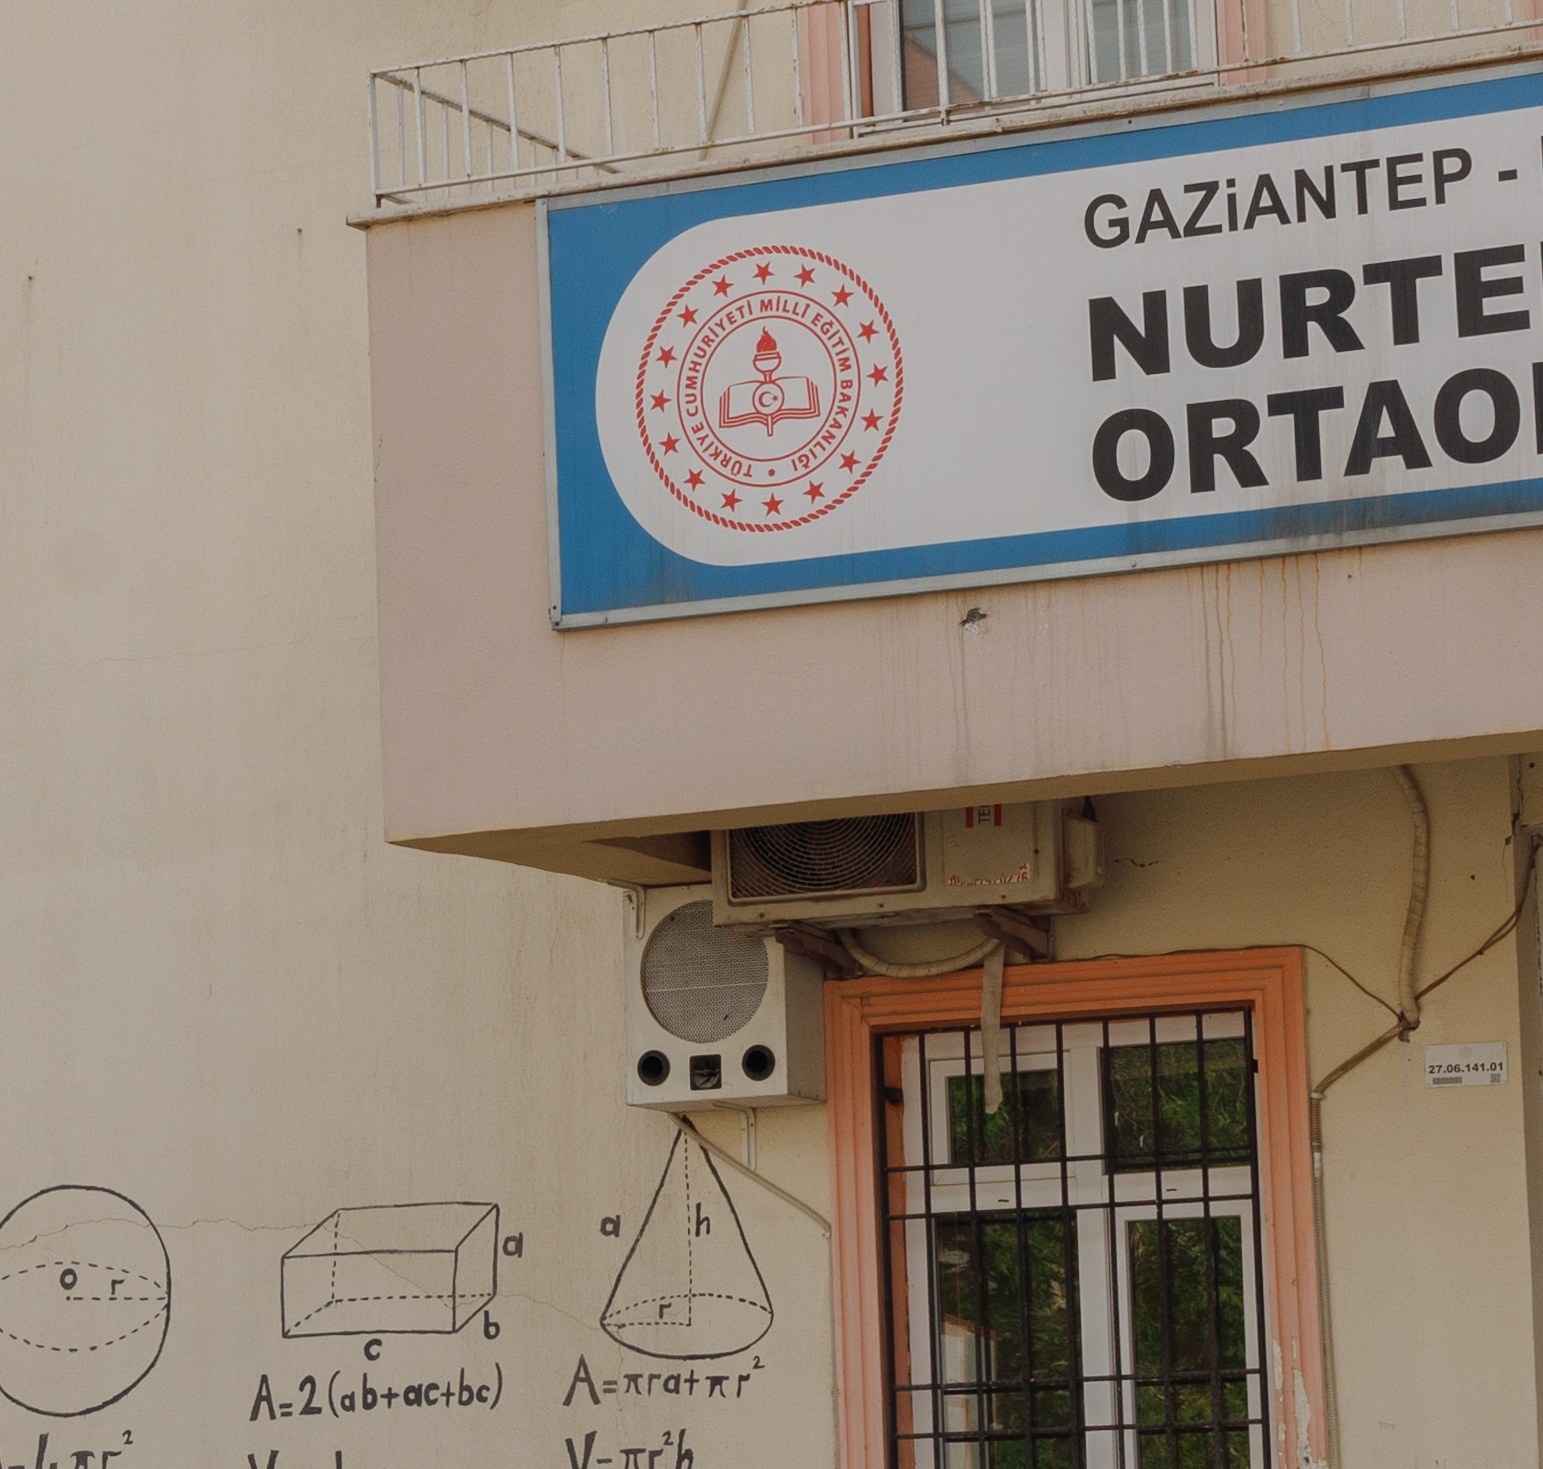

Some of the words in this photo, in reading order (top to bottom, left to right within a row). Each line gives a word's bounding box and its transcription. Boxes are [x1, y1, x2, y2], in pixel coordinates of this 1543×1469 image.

[684, 299, 754, 417] CUMHURİYETİ
[810, 311, 853, 373] EĞİTİM
[790, 378, 854, 472] BAKANLIĞI
[691, 421, 754, 478] TÜRKİYE
[1428, 1061, 1504, 1074] 27.06.141.01
[598, 1214, 622, 1239] a
[694, 1201, 712, 1238] h
[501, 1231, 524, 1259] a
[482, 1309, 501, 1341] b
[362, 1337, 384, 1362] c
